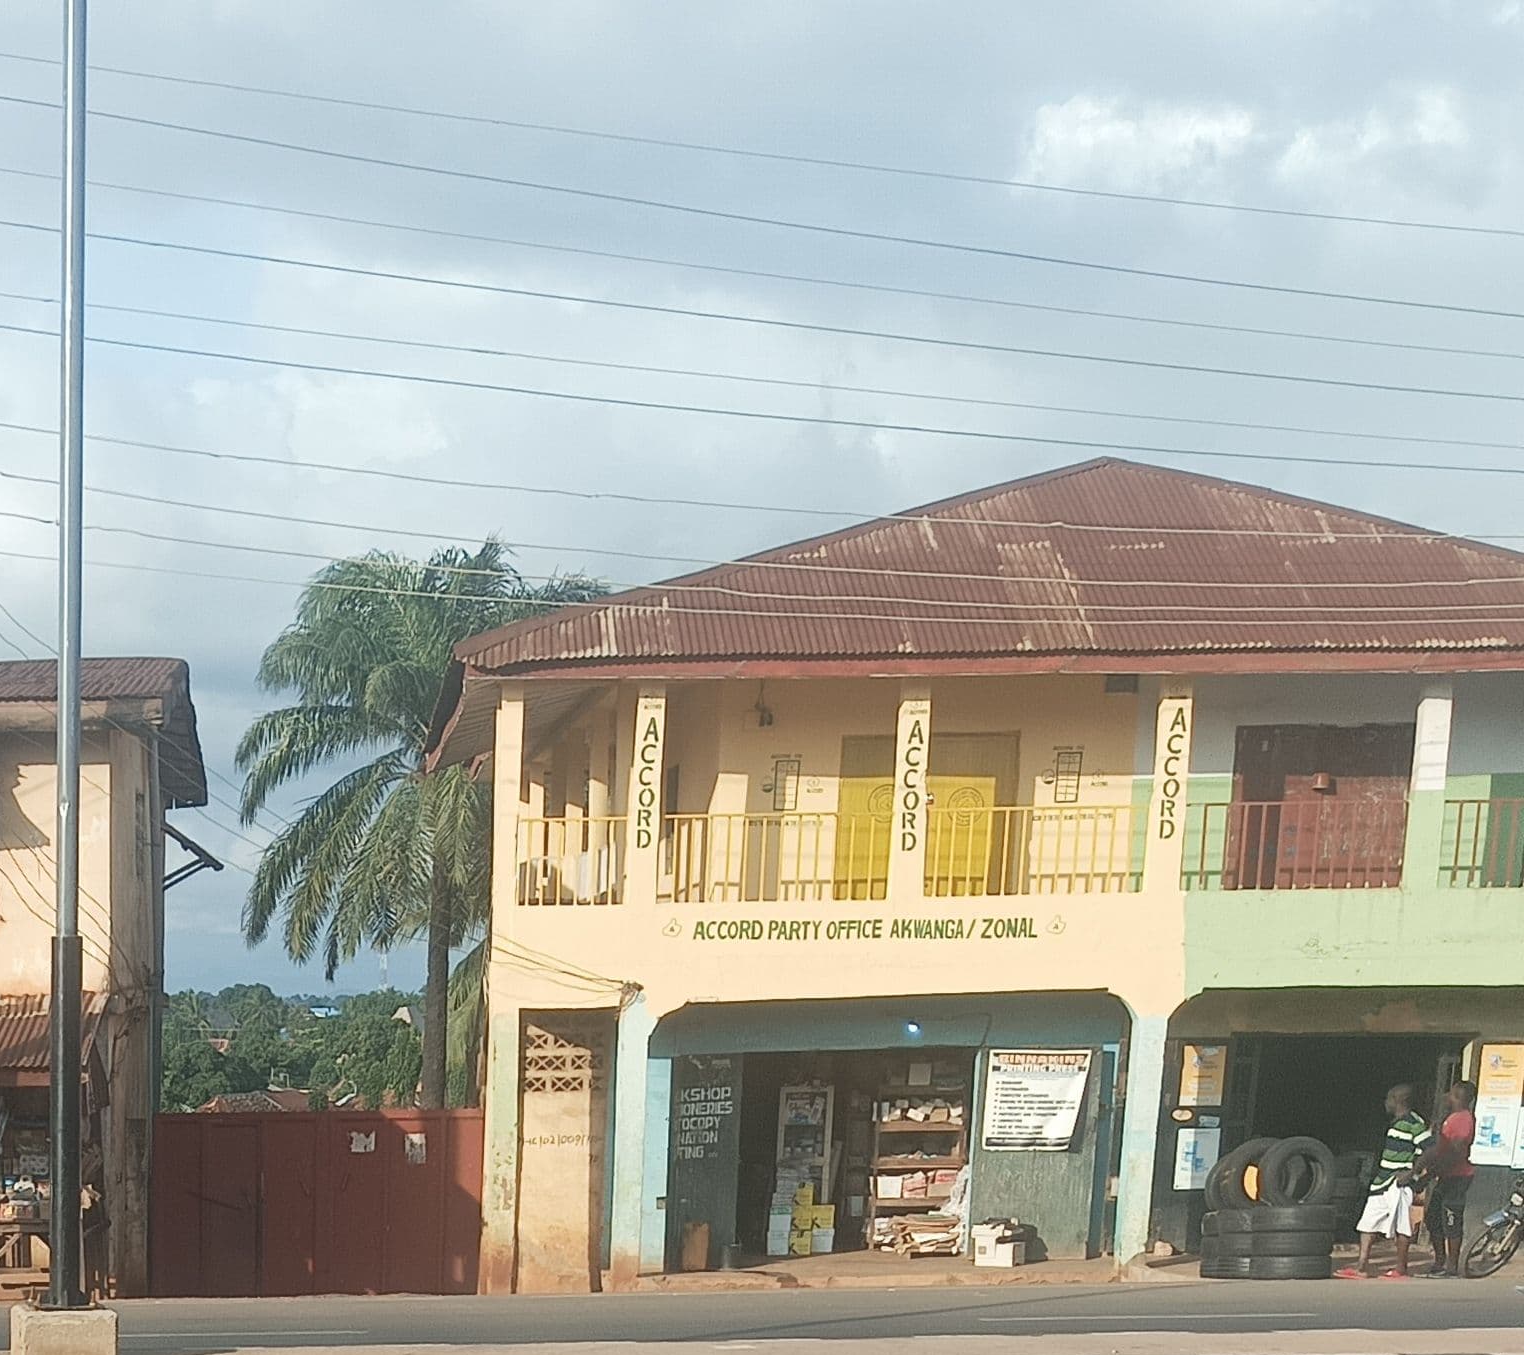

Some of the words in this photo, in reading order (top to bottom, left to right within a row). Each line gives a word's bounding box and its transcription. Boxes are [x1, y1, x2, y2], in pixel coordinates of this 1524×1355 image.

[637, 717, 659, 849] ACCORD
[901, 719, 924, 851] ACCORD
[1159, 707, 1186, 839] ACCORD
[693, 920, 764, 940] ACCORD
[767, 920, 822, 941] PARTY
[826, 919, 883, 940] OFFICE
[980, 917, 1038, 939] ZONAL
